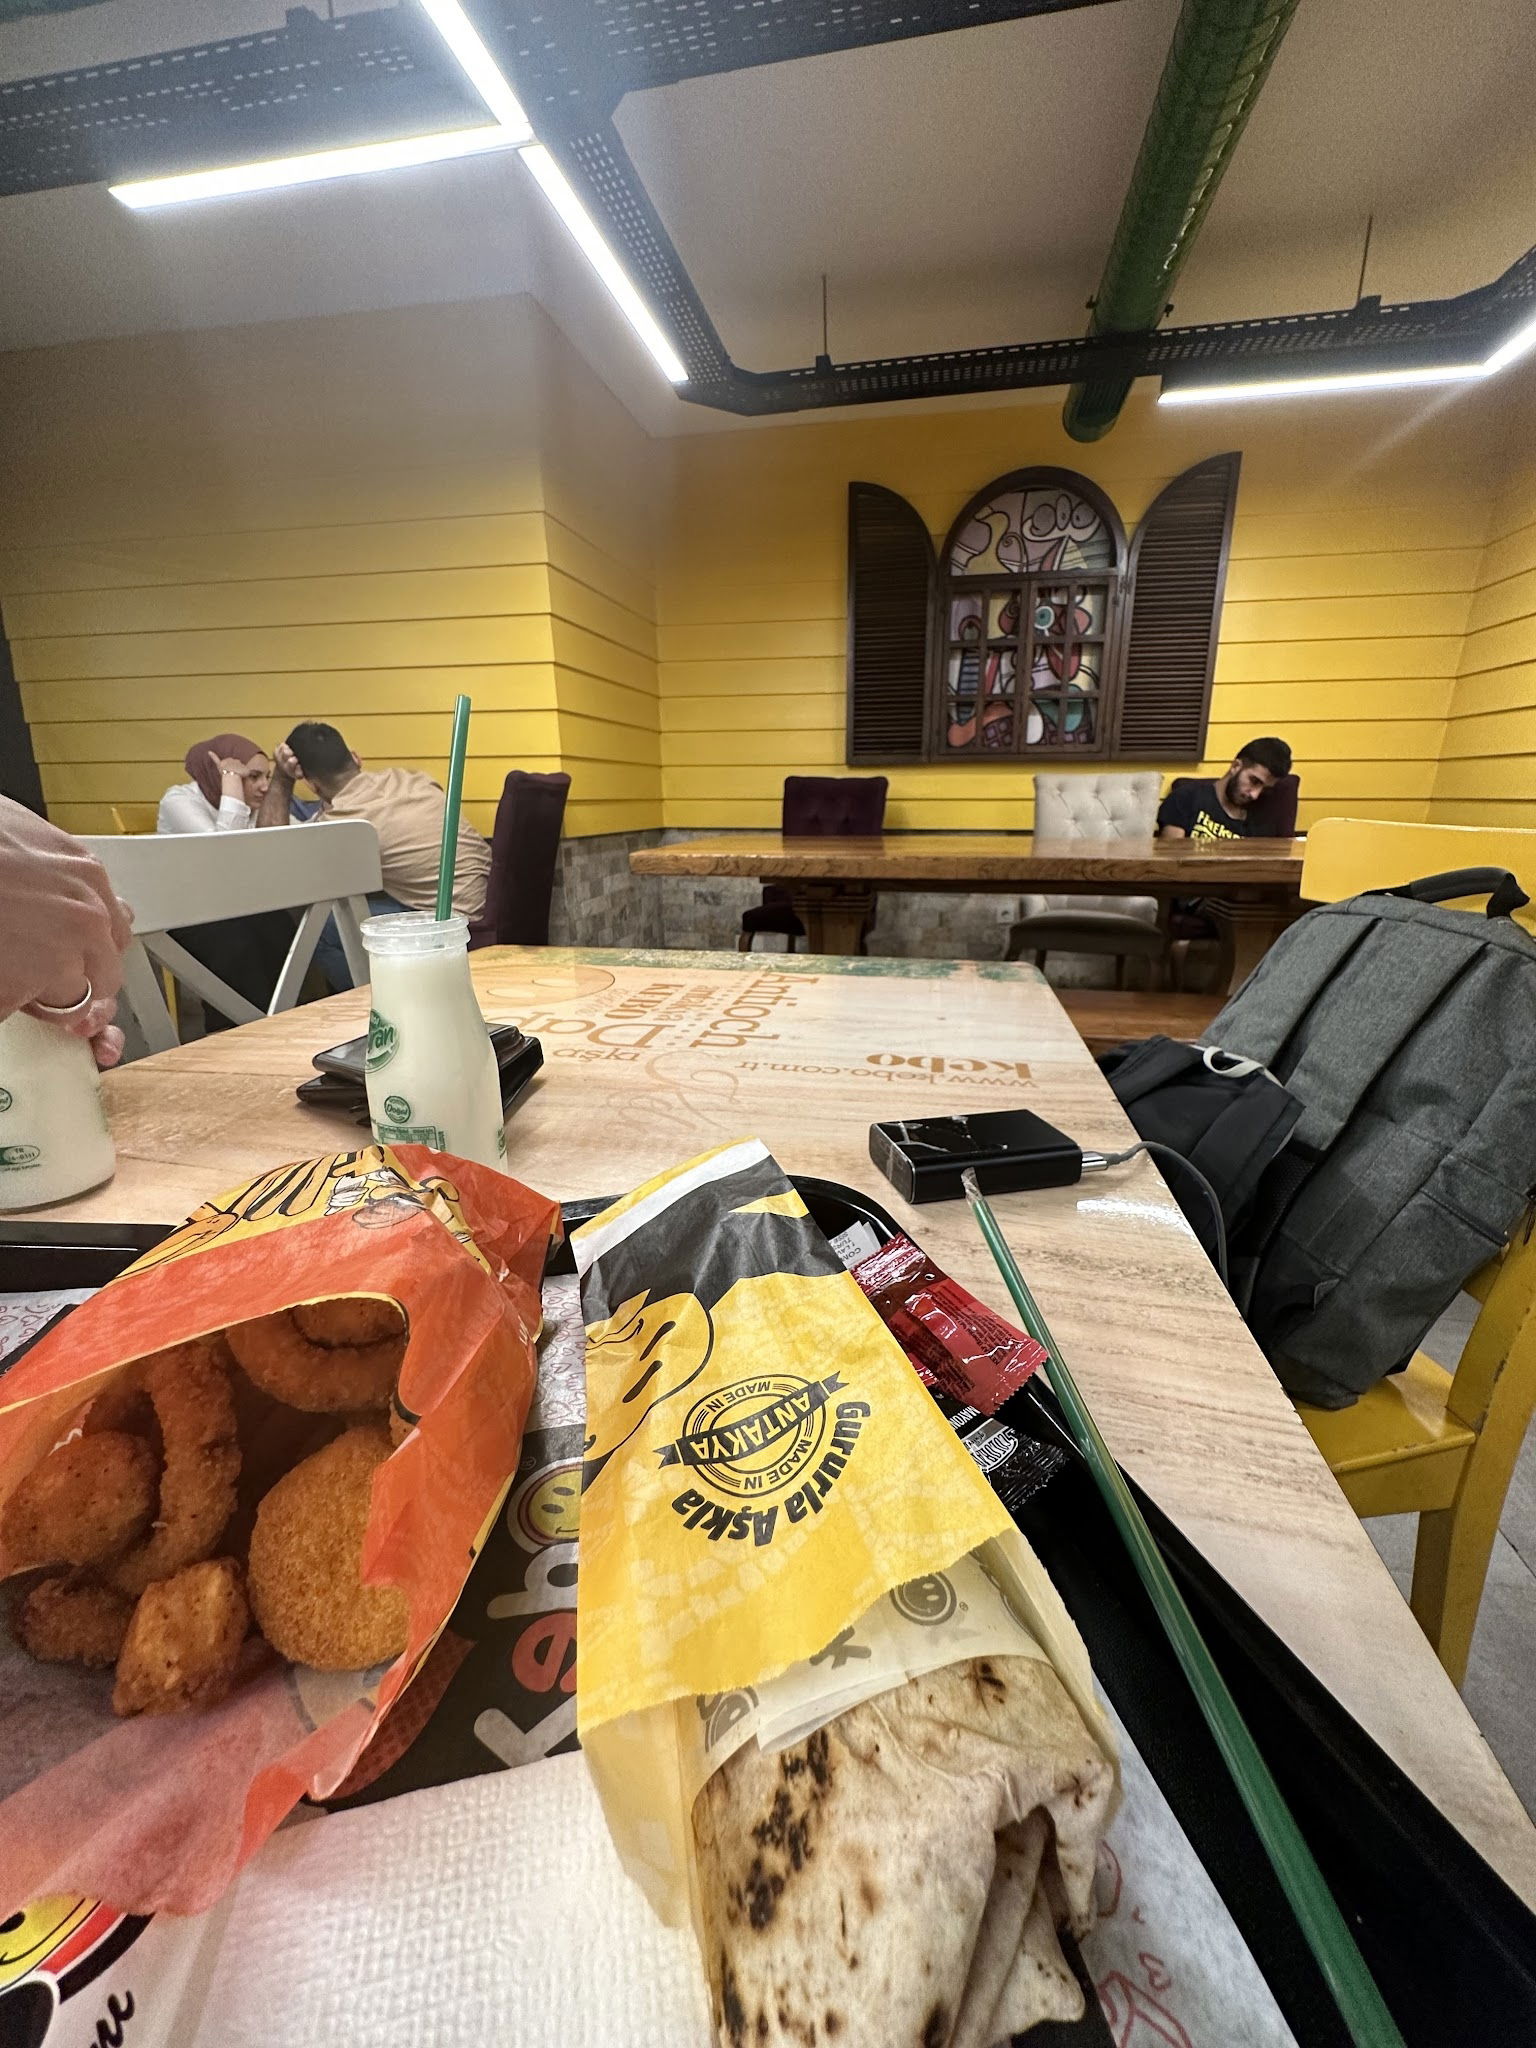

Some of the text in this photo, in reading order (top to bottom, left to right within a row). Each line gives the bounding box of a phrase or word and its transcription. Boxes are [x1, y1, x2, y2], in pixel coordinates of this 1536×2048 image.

[603, 983, 687, 1019] KEBO
[688, 971, 820, 1048] Antioch
[735, 1059, 1040, 1088] www.kebo.com.tr
[866, 1053, 1032, 1079] kebo
[705, 1380, 771, 1413] MADE IN
[689, 1391, 811, 1460] ANTAKYA
[671, 1401, 872, 1548] Gururla Aşkla
[743, 1438, 814, 1490] MADE IN
